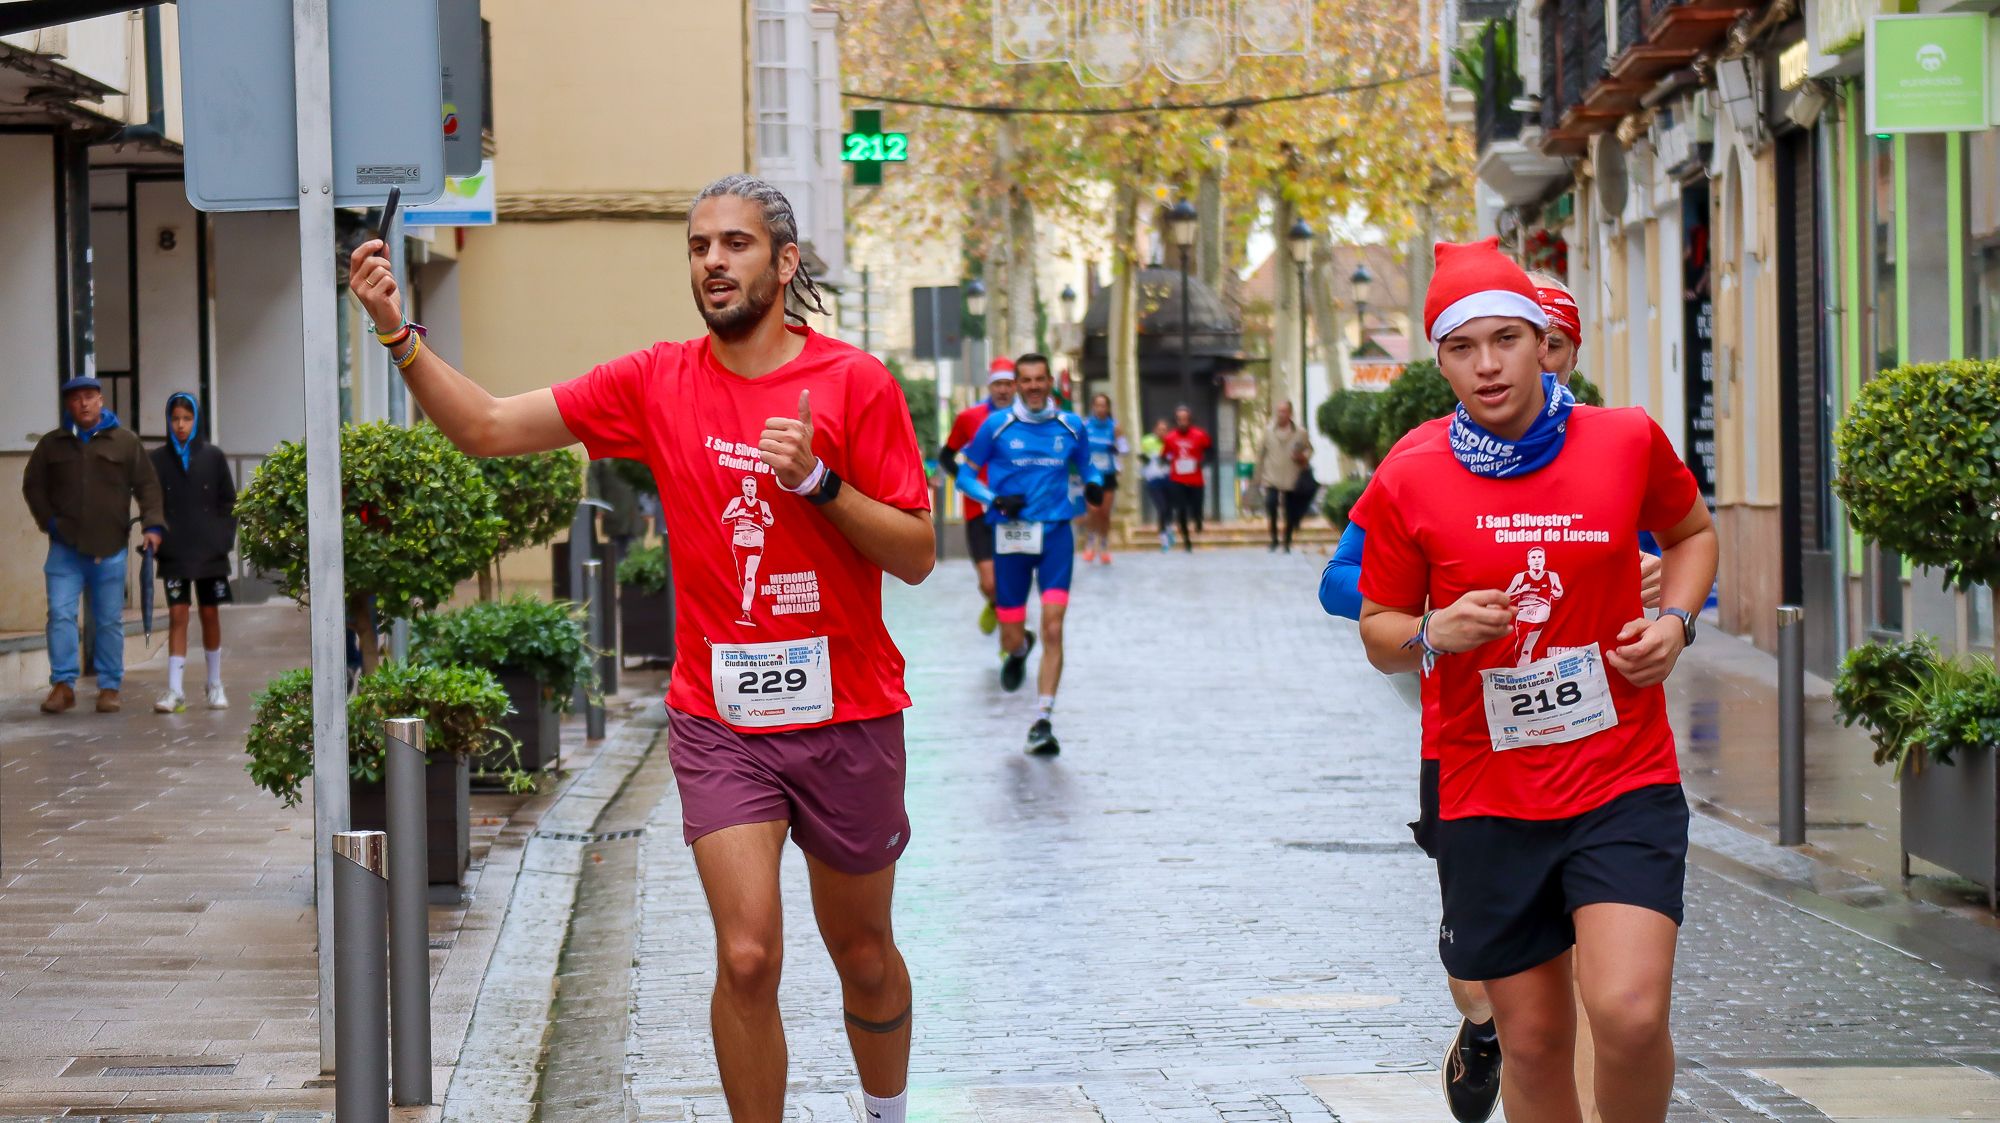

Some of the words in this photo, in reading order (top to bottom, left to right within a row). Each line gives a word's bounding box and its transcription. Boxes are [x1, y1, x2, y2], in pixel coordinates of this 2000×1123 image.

[159, 229, 177, 251] 8
[705, 436, 713, 448] I
[713, 439, 734, 454] San
[718, 453, 753, 472] Ciudad
[754, 461, 770, 473] de
[1476, 516, 1484, 529] I
[1485, 515, 1510, 528] San
[1512, 513, 1571, 528] Silvestre
[1495, 529, 1542, 543] Ciudad
[1543, 528, 1561, 542] de
[1563, 528, 1610, 543] Lucena
[769, 570, 817, 585] MEMORIAL
[760, 585, 782, 596] JOSE
[783, 581, 819, 594] CARLOS
[776, 591, 820, 604] HURTADO
[771, 601, 821, 616] MARJALIZO
[738, 668, 807, 694] 229
[1494, 683, 1517, 691] Ciudad
[1528, 677, 1555, 688] Lucena
[1511, 681, 1582, 716] 218
[1571, 712, 1603, 726] enerplus
